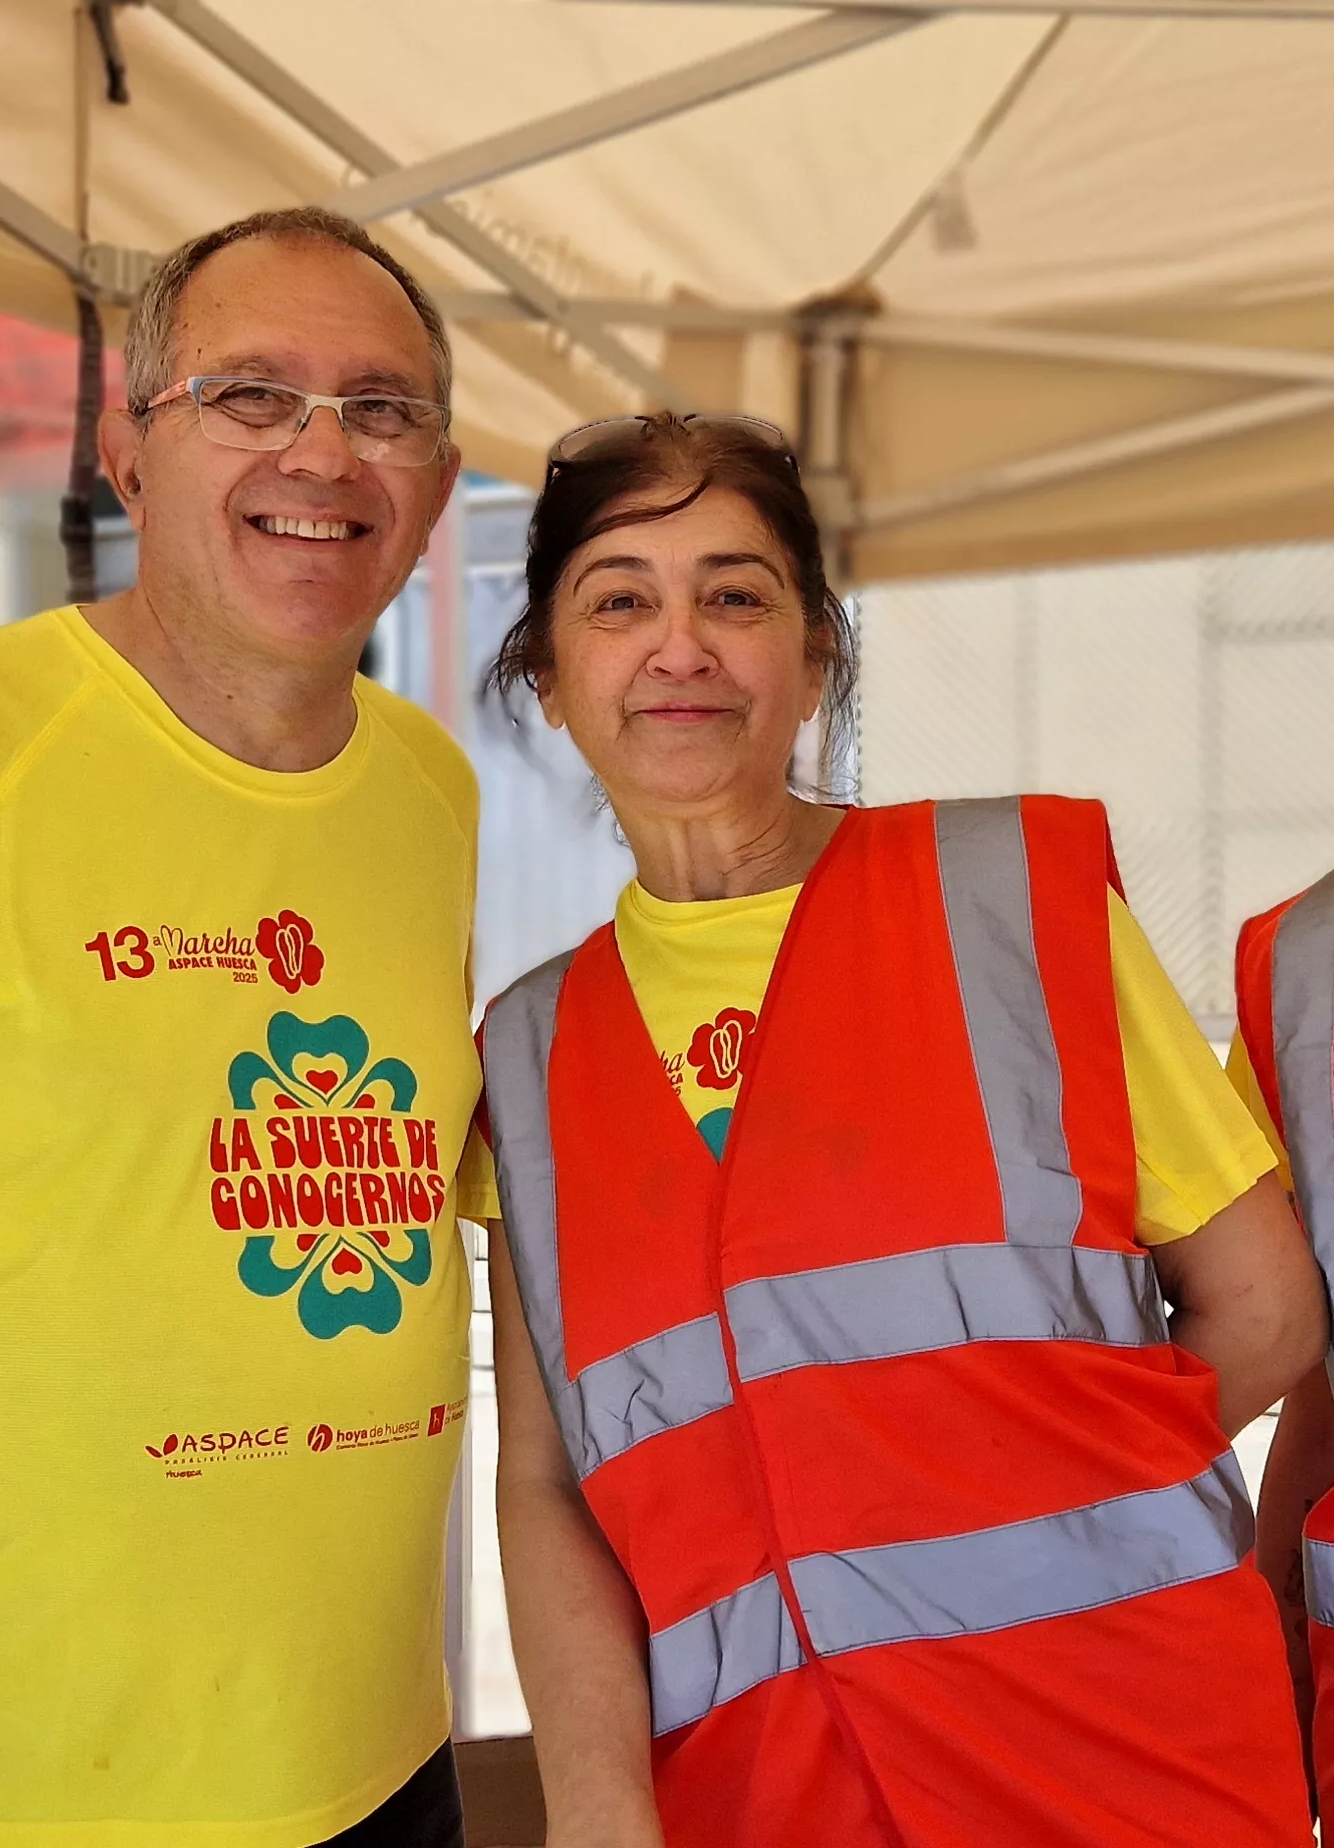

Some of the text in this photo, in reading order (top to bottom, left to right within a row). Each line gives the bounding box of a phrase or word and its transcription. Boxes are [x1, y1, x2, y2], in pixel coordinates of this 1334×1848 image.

[160, 924, 255, 957] Marcha
[168, 955, 257, 971] ASPACE HUESCA
[232, 971, 259, 984] 2025
[210, 1116, 439, 1173] LA SUERTE DE
[210, 1171, 445, 1231] CONOCERNOS
[181, 1425, 290, 1455] ASPACE
[336, 1429, 368, 1443] hoya
[369, 1424, 383, 1438] de
[385, 1419, 420, 1436] huesca
